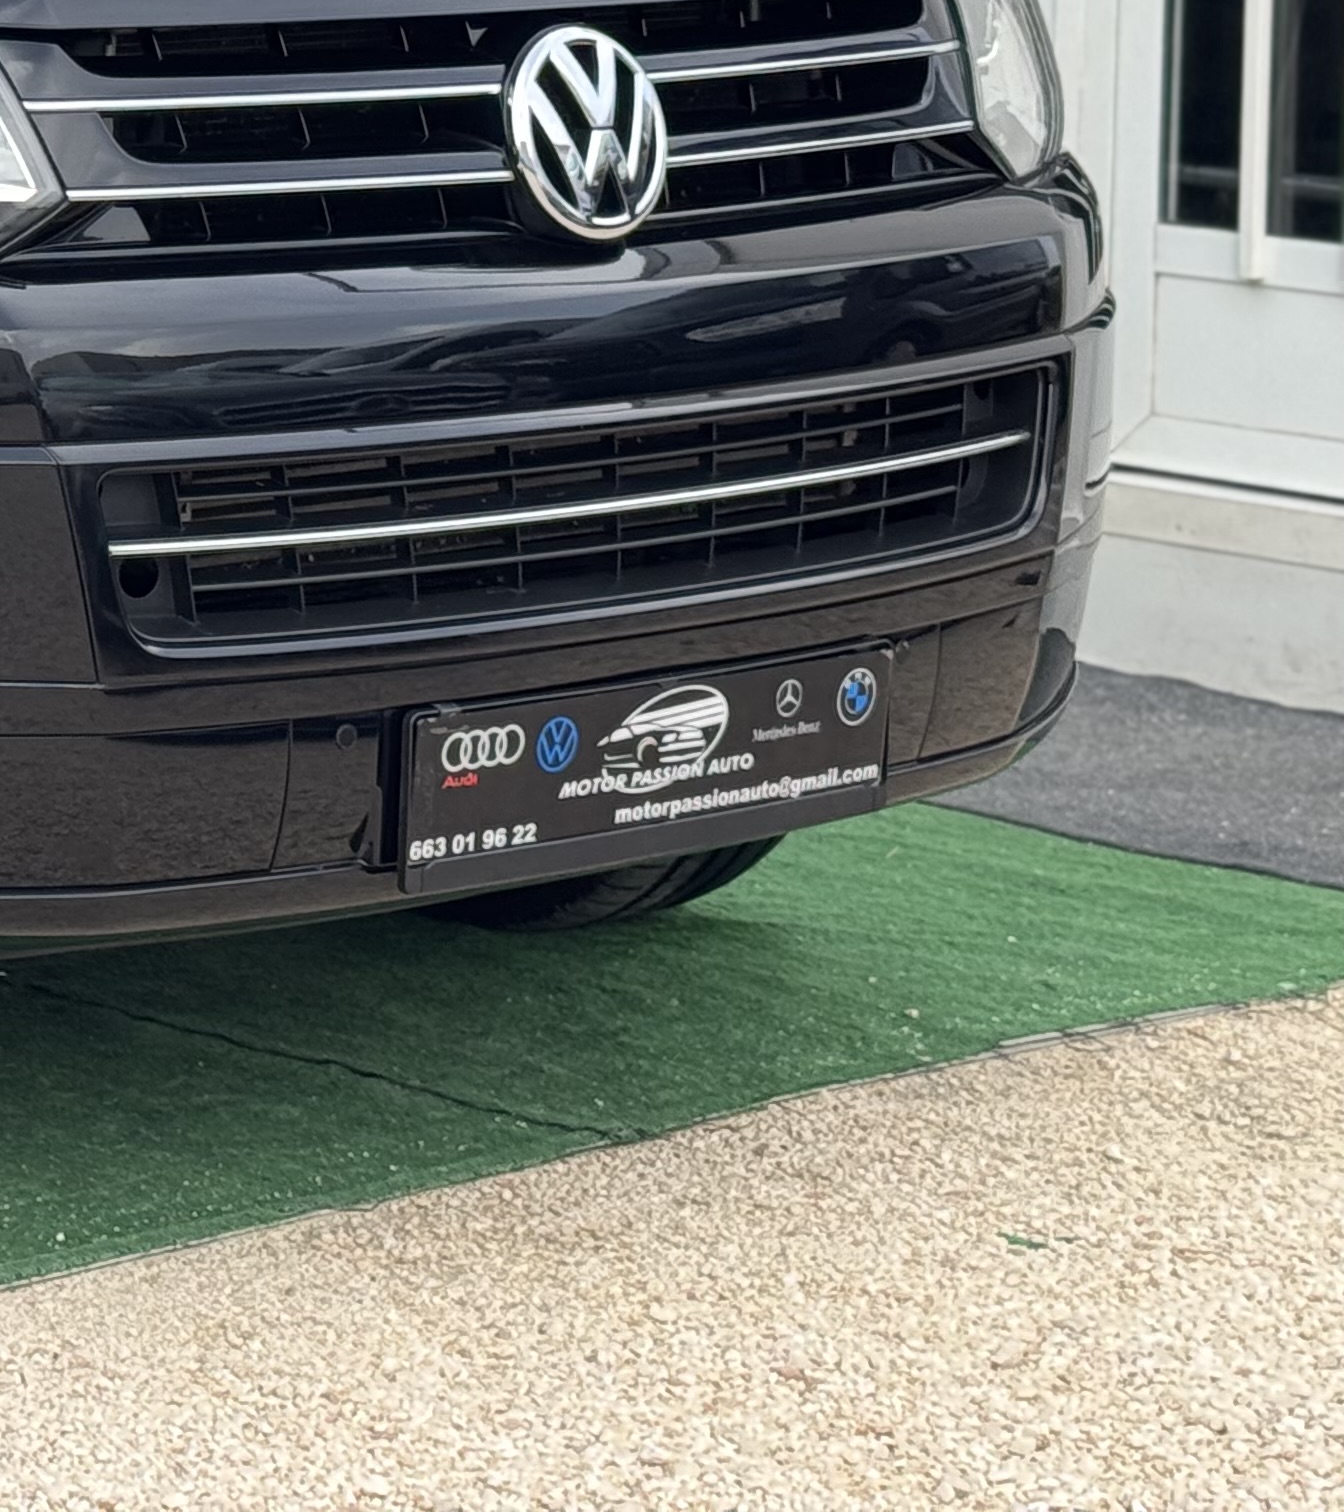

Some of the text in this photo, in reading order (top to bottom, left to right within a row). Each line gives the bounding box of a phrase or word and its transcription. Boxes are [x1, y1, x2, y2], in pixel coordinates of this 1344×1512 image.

[441, 772, 478, 789] Audi
[558, 752, 754, 799] MOTOR PASSION AUTO
[614, 763, 879, 824] motorpassionauto@gmail.com
[409, 823, 537, 860] 663 01 96 22
